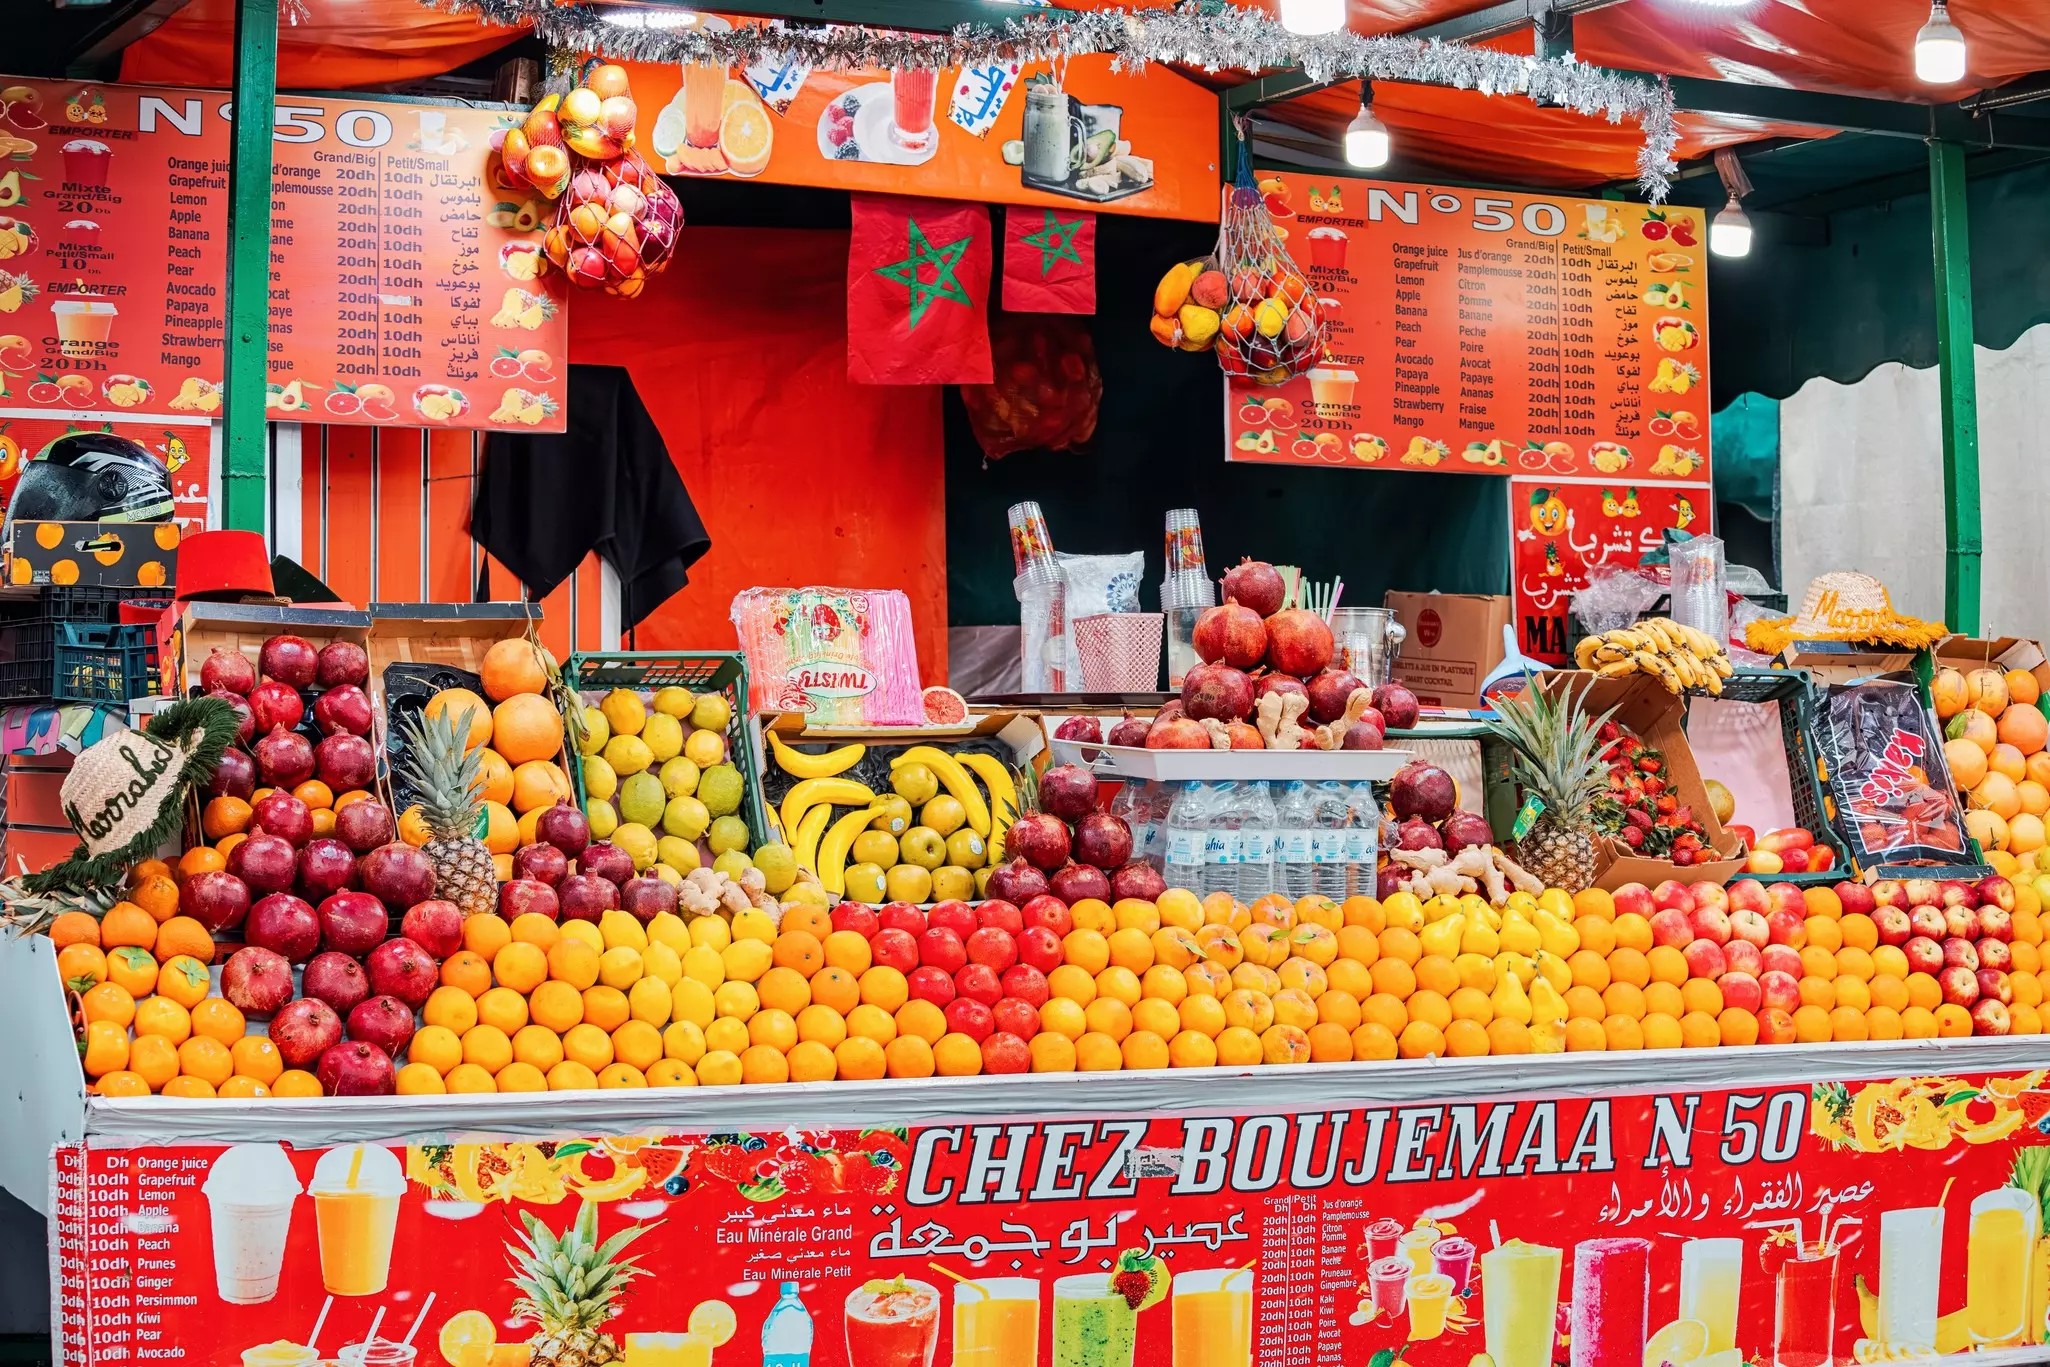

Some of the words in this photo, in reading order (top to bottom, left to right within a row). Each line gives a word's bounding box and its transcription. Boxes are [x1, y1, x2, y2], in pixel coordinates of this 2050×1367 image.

[48, 125, 132, 139] EMPORTER
[273, 105, 393, 148] 50
[168, 157, 208, 173] Orange
[211, 159, 230, 173] juic
[314, 151, 376, 167] Grand/Big
[388, 156, 448, 171] Petit/Small
[337, 169, 375, 180] 20dh
[385, 172, 422, 184] 10dh
[62, 182, 111, 193] Mixte
[169, 174, 226, 189] Grapefruit
[430, 174, 480, 190] البرتقال
[44, 191, 121, 203] Grand/Big
[170, 192, 207, 205] Lemon
[58, 201, 92, 213] 20
[170, 209, 201, 224] Apple
[1297, 215, 1364, 228] EMPORTER
[1472, 197, 1567, 236] 50
[169, 227, 209, 240] Banana
[452, 227, 478, 242] تفاح
[59, 243, 102, 252] Mixte
[168, 245, 200, 258] Peach
[1393, 243, 1424, 256] Orange
[1427, 245, 1448, 257] juice
[1506, 239, 1554, 253] Grand/Big
[1563, 244, 1611, 256] Petit/Small
[46, 250, 114, 260] Petit/Small
[1458, 248, 1472, 258] Jus
[1474, 250, 1512, 264] d'orange
[1524, 255, 1554, 264] 20dh
[60, 259, 86, 269] 10
[1394, 258, 1438, 271] Grapefruit
[1562, 258, 1591, 268] 10dh
[1597, 259, 1637, 274] البرتقال
[168, 263, 194, 276] Pear
[1310, 265, 1349, 275] Mixte
[1458, 263, 1522, 277] Pamplemousse
[1396, 274, 1424, 286] Lemon
[1562, 273, 1591, 282] 10dh
[47, 283, 127, 296] EMPORTER
[166, 282, 215, 296] Avocado
[1458, 279, 1485, 290] Citron
[1396, 289, 1420, 302] Apple
[1459, 295, 1492, 306] Pomme
[1606, 290, 1638, 301] حامض
[166, 299, 208, 314] Papaya
[1395, 304, 1427, 316] Banana
[1616, 305, 1636, 318] تفاح
[1459, 309, 1492, 321] Banane
[165, 315, 222, 331] Pineapple
[1396, 321, 1421, 332] Peach
[1622, 319, 1638, 331] موز
[1459, 325, 1486, 337] Peche
[42, 337, 119, 349] Orange
[1396, 337, 1416, 347] Pear
[1460, 341, 1483, 352] Poire
[1617, 334, 1638, 347] خوخ
[46, 348, 118, 357] Grand/Big
[337, 344, 375, 356] 20dh
[383, 347, 421, 358] 10dh
[161, 352, 200, 368] Mango
[1395, 353, 1433, 365] Avocado
[1460, 357, 1491, 369] Avocat
[1396, 368, 1428, 381] Papaya
[1461, 372, 1493, 385] Papaye
[1395, 382, 1439, 395] Pineapple
[1461, 387, 1493, 398] Ananas
[1301, 400, 1361, 411] Orange
[1393, 398, 1444, 413] Strawberry
[1460, 403, 1486, 414] Fraise
[1304, 410, 1360, 418] Grand/Big
[1528, 408, 1558, 418] 20dh
[1394, 414, 1424, 428] Mango
[1459, 418, 1494, 432] Mangue
[1528, 424, 1559, 434] 20dh
[905, 1118, 1153, 1207] CHEZ
[1170, 1098, 1616, 1195] BOUJEMAA
[1644, 1092, 1701, 1170] N
[1720, 1090, 1807, 1166] 50
[107, 1157, 129, 1168] Dh
[138, 1157, 178, 1171] Orange
[181, 1157, 208, 1171] juice
[89, 1174, 129, 1186] 10dh
[139, 1174, 195, 1188] Grapefruit
[139, 1189, 175, 1200] Lemon
[1722, 1171, 1803, 1219] الفقراء
[823, 1203, 851, 1218] ماء
[1323, 1200, 1333, 1209] Jus
[138, 1204, 169, 1218] Apple
[720, 1206, 754, 1223] كبير
[761, 1204, 815, 1225] معدني
[1323, 1211, 1369, 1222] Pamplemousse
[1263, 1216, 1287, 1225] 20dh
[1292, 1215, 1316, 1223] 10dh
[138, 1222, 179, 1233] Banana
[1322, 1223, 1342, 1233] Citron
[716, 1228, 743, 1244] Eau
[748, 1226, 806, 1243] Minérale
[811, 1224, 852, 1241] Grand
[1133, 1209, 1249, 1261] عصير
[1322, 1232, 1346, 1241] Pomme
[90, 1238, 128, 1251] 10dh
[138, 1238, 170, 1250] Peach
[1322, 1245, 1346, 1254] Banane
[746, 1249, 781, 1263] صغير
[786, 1248, 824, 1263] معدني
[830, 1247, 850, 1257] ماء
[1262, 1250, 1286, 1259] 20dh
[138, 1258, 176, 1269] Prunes
[744, 1268, 766, 1280] Eau
[771, 1267, 820, 1279] Minérale
[825, 1266, 851, 1277] Petit
[1321, 1269, 1352, 1278] Pruneaux
[137, 1276, 173, 1290] Ginger
[1320, 1279, 1357, 1291] Gingembre
[136, 1294, 197, 1306] Persimmon
[1320, 1294, 1334, 1303] Kaki
[1320, 1305, 1334, 1315] Kiwi
[93, 1312, 131, 1326] 10dh
[137, 1312, 160, 1324] Kiwi
[1319, 1319, 1336, 1327] Poire
[1288, 1322, 1312, 1330] 10dh
[137, 1329, 161, 1340] Pear
[1318, 1329, 1341, 1338] Avocat
[137, 1346, 185, 1358] Avocado
[1318, 1342, 1341, 1352] Papaye
[1317, 1353, 1341, 1362] Ananas
